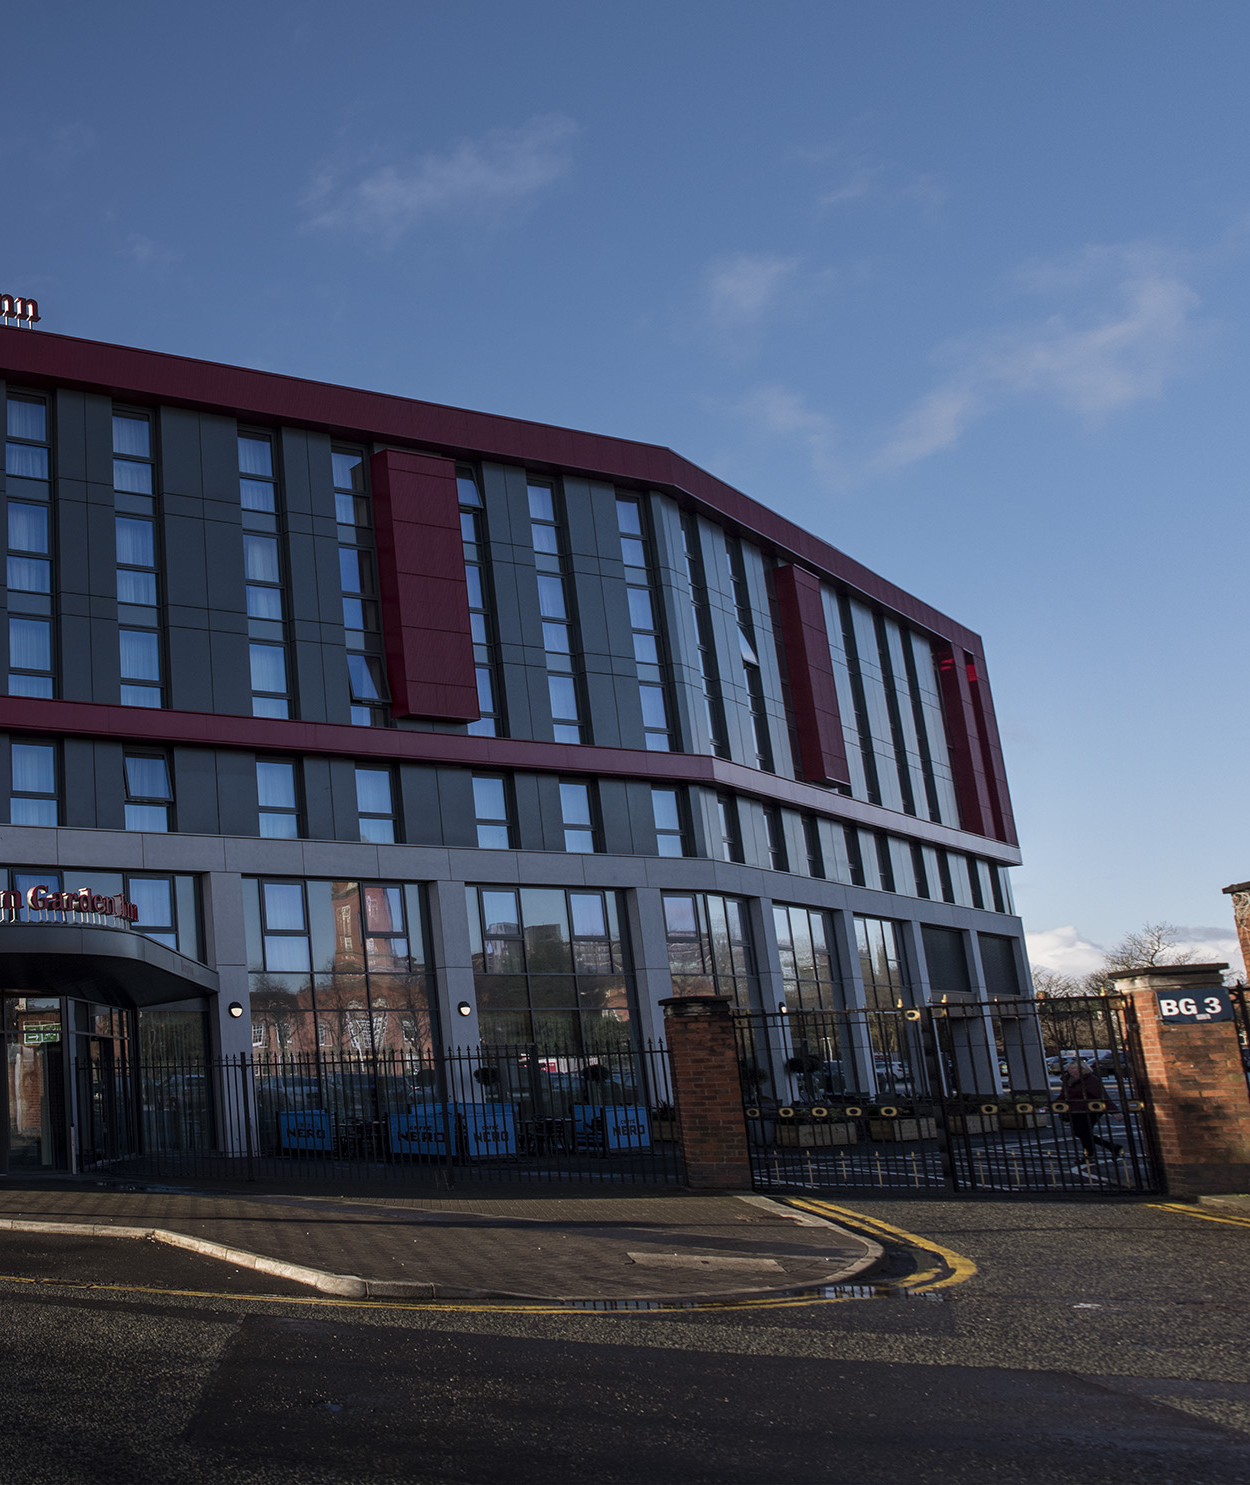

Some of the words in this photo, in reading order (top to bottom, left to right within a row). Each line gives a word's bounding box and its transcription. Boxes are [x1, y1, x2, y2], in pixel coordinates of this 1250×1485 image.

[27, 885, 118, 917] Garden
[1159, 998, 1198, 1016] BG
[1204, 997, 1222, 1014] 3
[287, 1128, 326, 1139] NERO
[612, 1125, 645, 1136] NERO
[397, 1131, 446, 1143] NERO
[473, 1131, 509, 1142] NERO
